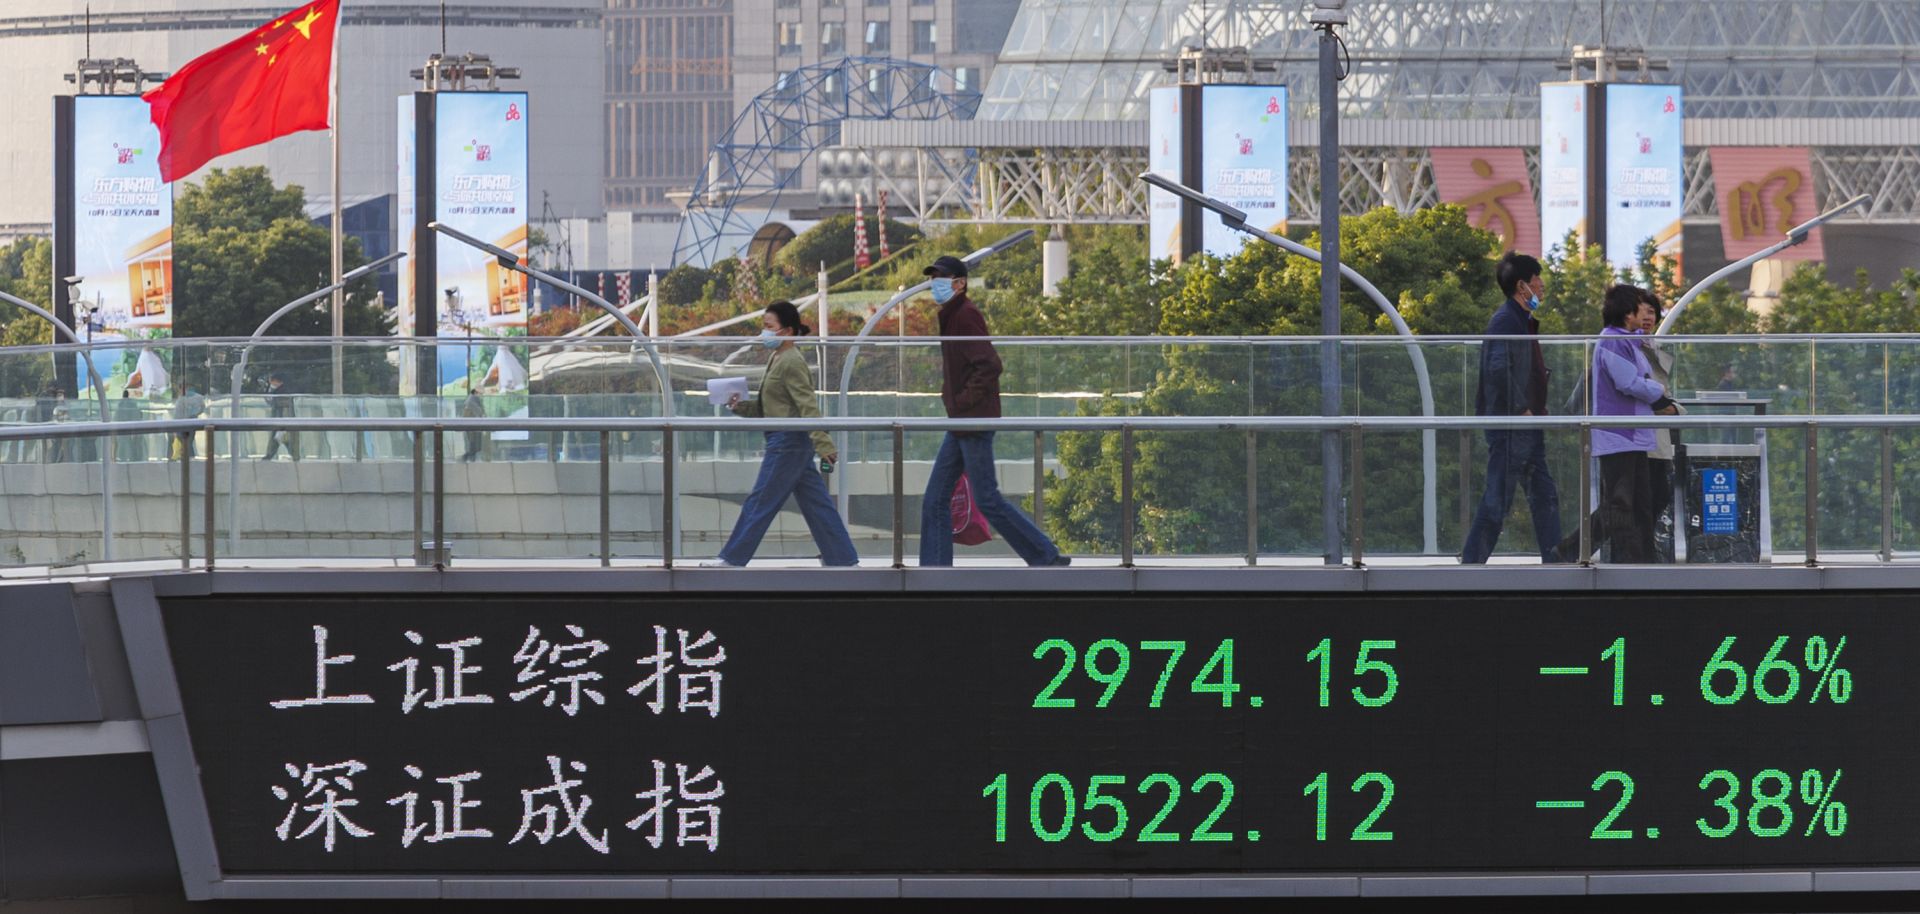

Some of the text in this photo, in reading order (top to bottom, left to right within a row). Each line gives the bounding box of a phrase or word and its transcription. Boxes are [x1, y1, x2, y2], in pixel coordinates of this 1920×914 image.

[95, 177, 156, 193] 东方购物
[453, 174, 511, 190] 东方购物
[269, 624, 1852, 718] 上证综指 2974.15 -1.66%
[270, 755, 1848, 854] 深证成指 10522.12 -2.38%
